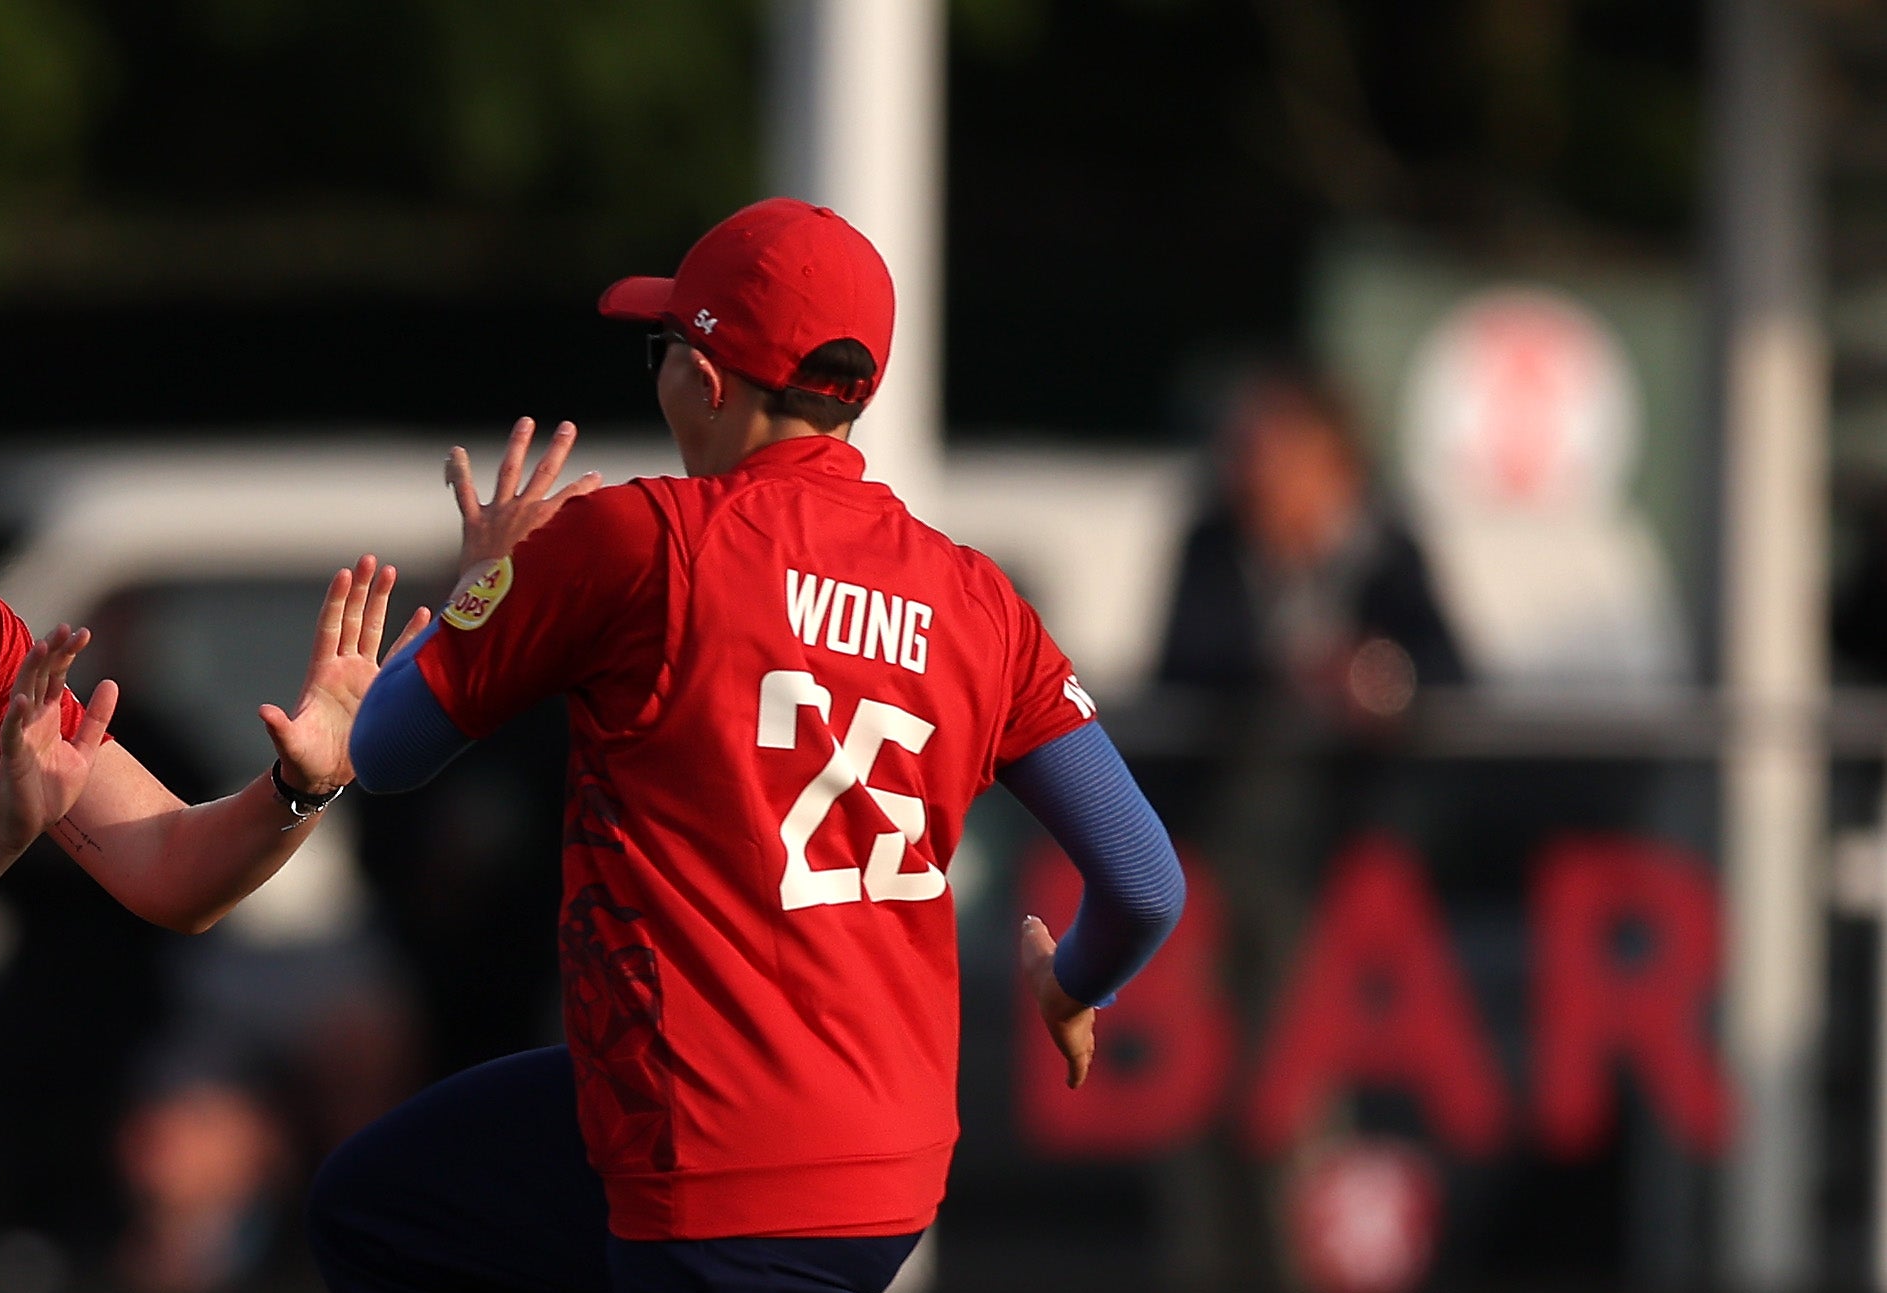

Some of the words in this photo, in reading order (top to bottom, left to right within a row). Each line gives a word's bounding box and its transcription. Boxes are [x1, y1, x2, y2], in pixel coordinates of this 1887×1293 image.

[694, 308, 718, 335] 54
[786, 567, 933, 675] WONG
[756, 669, 947, 911] 25
[1016, 832, 1744, 1166] BAR
